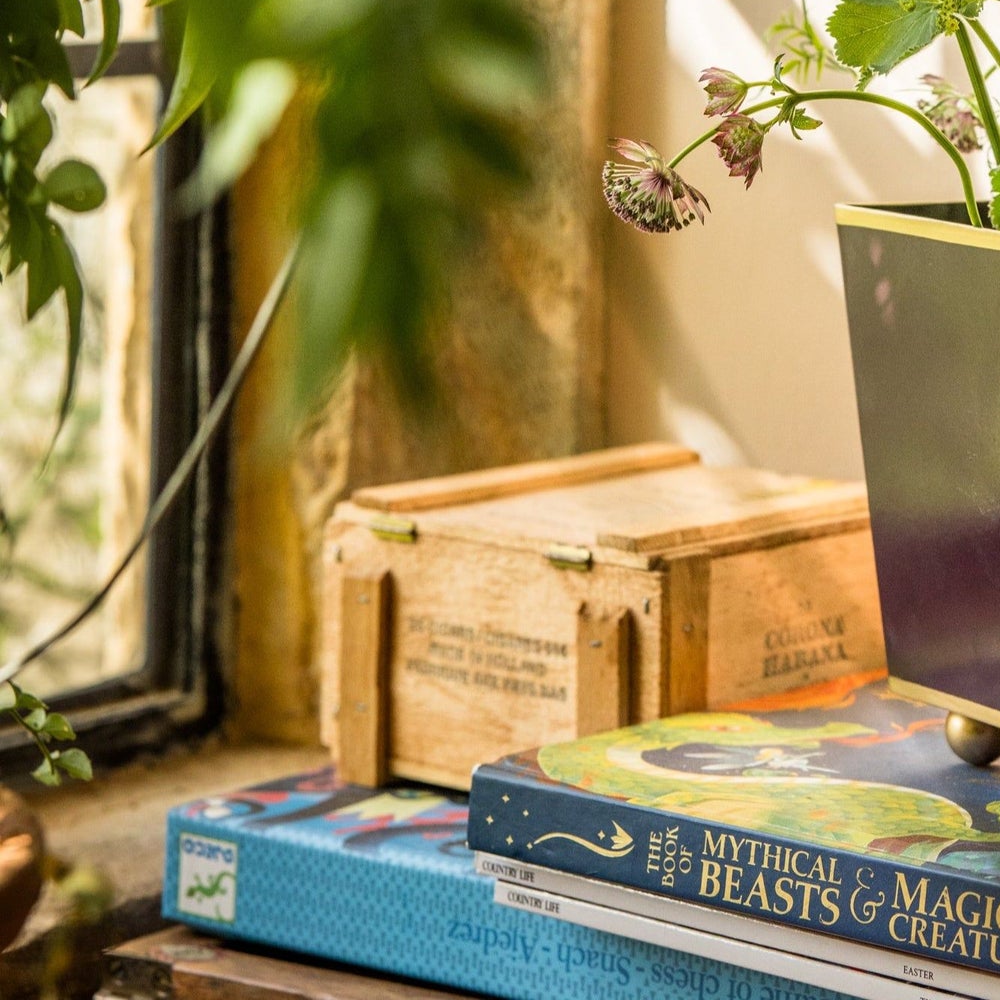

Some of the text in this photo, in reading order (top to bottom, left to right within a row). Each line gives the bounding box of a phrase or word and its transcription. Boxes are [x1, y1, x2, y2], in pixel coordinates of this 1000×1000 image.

[482, 860, 536, 883] COUNTRY LIFE
[646, 831, 663, 874] THE
[661, 825, 680, 888] BOOK
[679, 844, 693, 875] OF
[702, 829, 842, 885] MYTHICAL
[507, 890, 560, 914] COUNTRY LIFE
[698, 859, 841, 926] BEASTS
[850, 866, 886, 924] &
[448, 919, 538, 964] Ajedrez
[557, 943, 631, 986] Snach
[651, 962, 720, 1000] chess
[903, 965, 935, 981] EASTER
